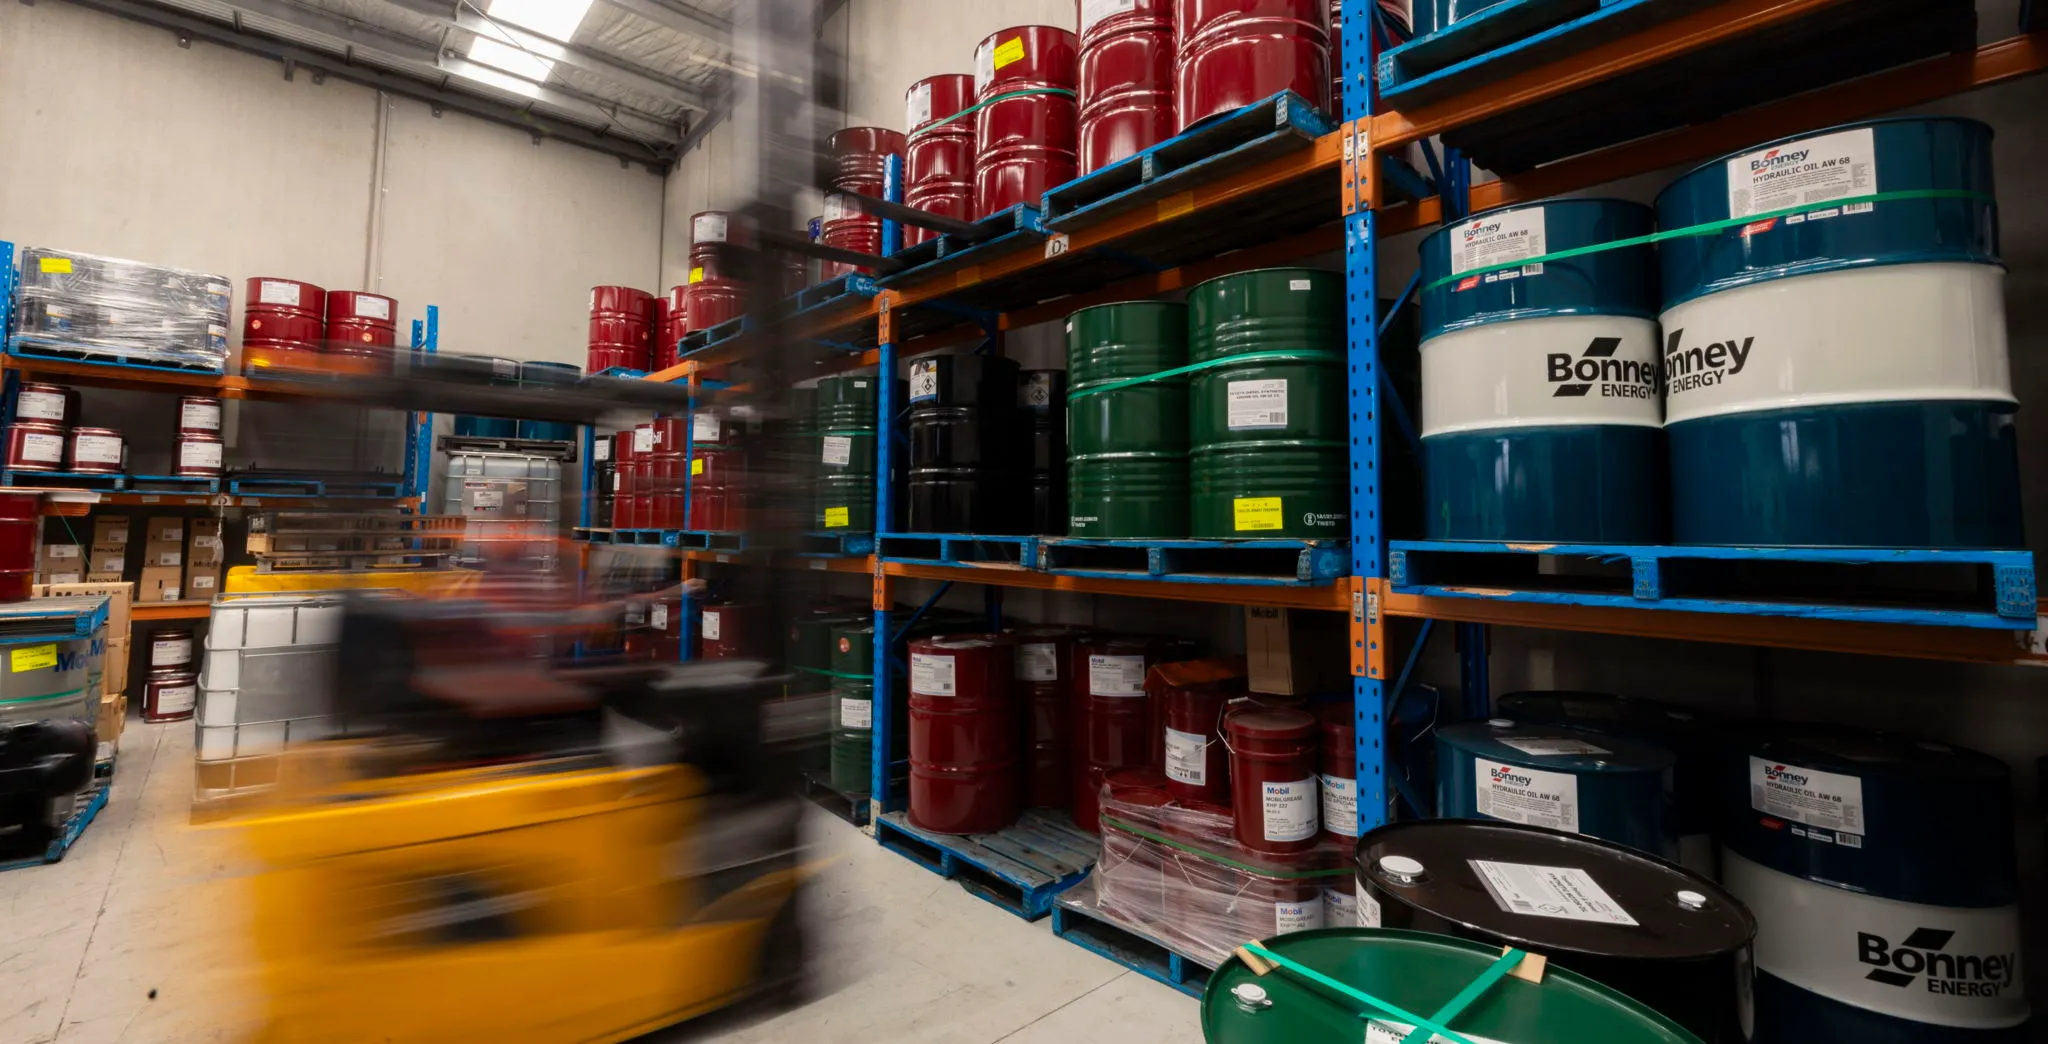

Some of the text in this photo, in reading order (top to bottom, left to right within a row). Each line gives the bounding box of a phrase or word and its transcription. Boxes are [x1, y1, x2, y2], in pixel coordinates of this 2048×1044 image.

[1750, 149, 1810, 172] Bonney
[1752, 156, 1851, 184] HYDRAULIC OIL AW 68
[1463, 222, 1502, 238] Bonney
[1464, 237, 1496, 249] HYDRAULIC
[1496, 233, 1507, 241] OIL
[1664, 336, 1755, 376] onney
[1547, 353, 1660, 394] Bonney
[1673, 368, 1725, 394] ENERGY
[1601, 383, 1652, 399] ENERGY
[1324, 779, 1346, 790] Mobil
[1490, 768, 1532, 786] Bonney
[1764, 765, 1809, 786] Bonney
[1266, 787, 1290, 795] Mobil
[1492, 784, 1560, 802] HYDRAULIC OIL AW 68
[1766, 781, 1842, 803] HYDRAULIC OIL AW 68
[1857, 931, 2016, 988] Bonney
[1927, 978, 2001, 997] ENERGY
